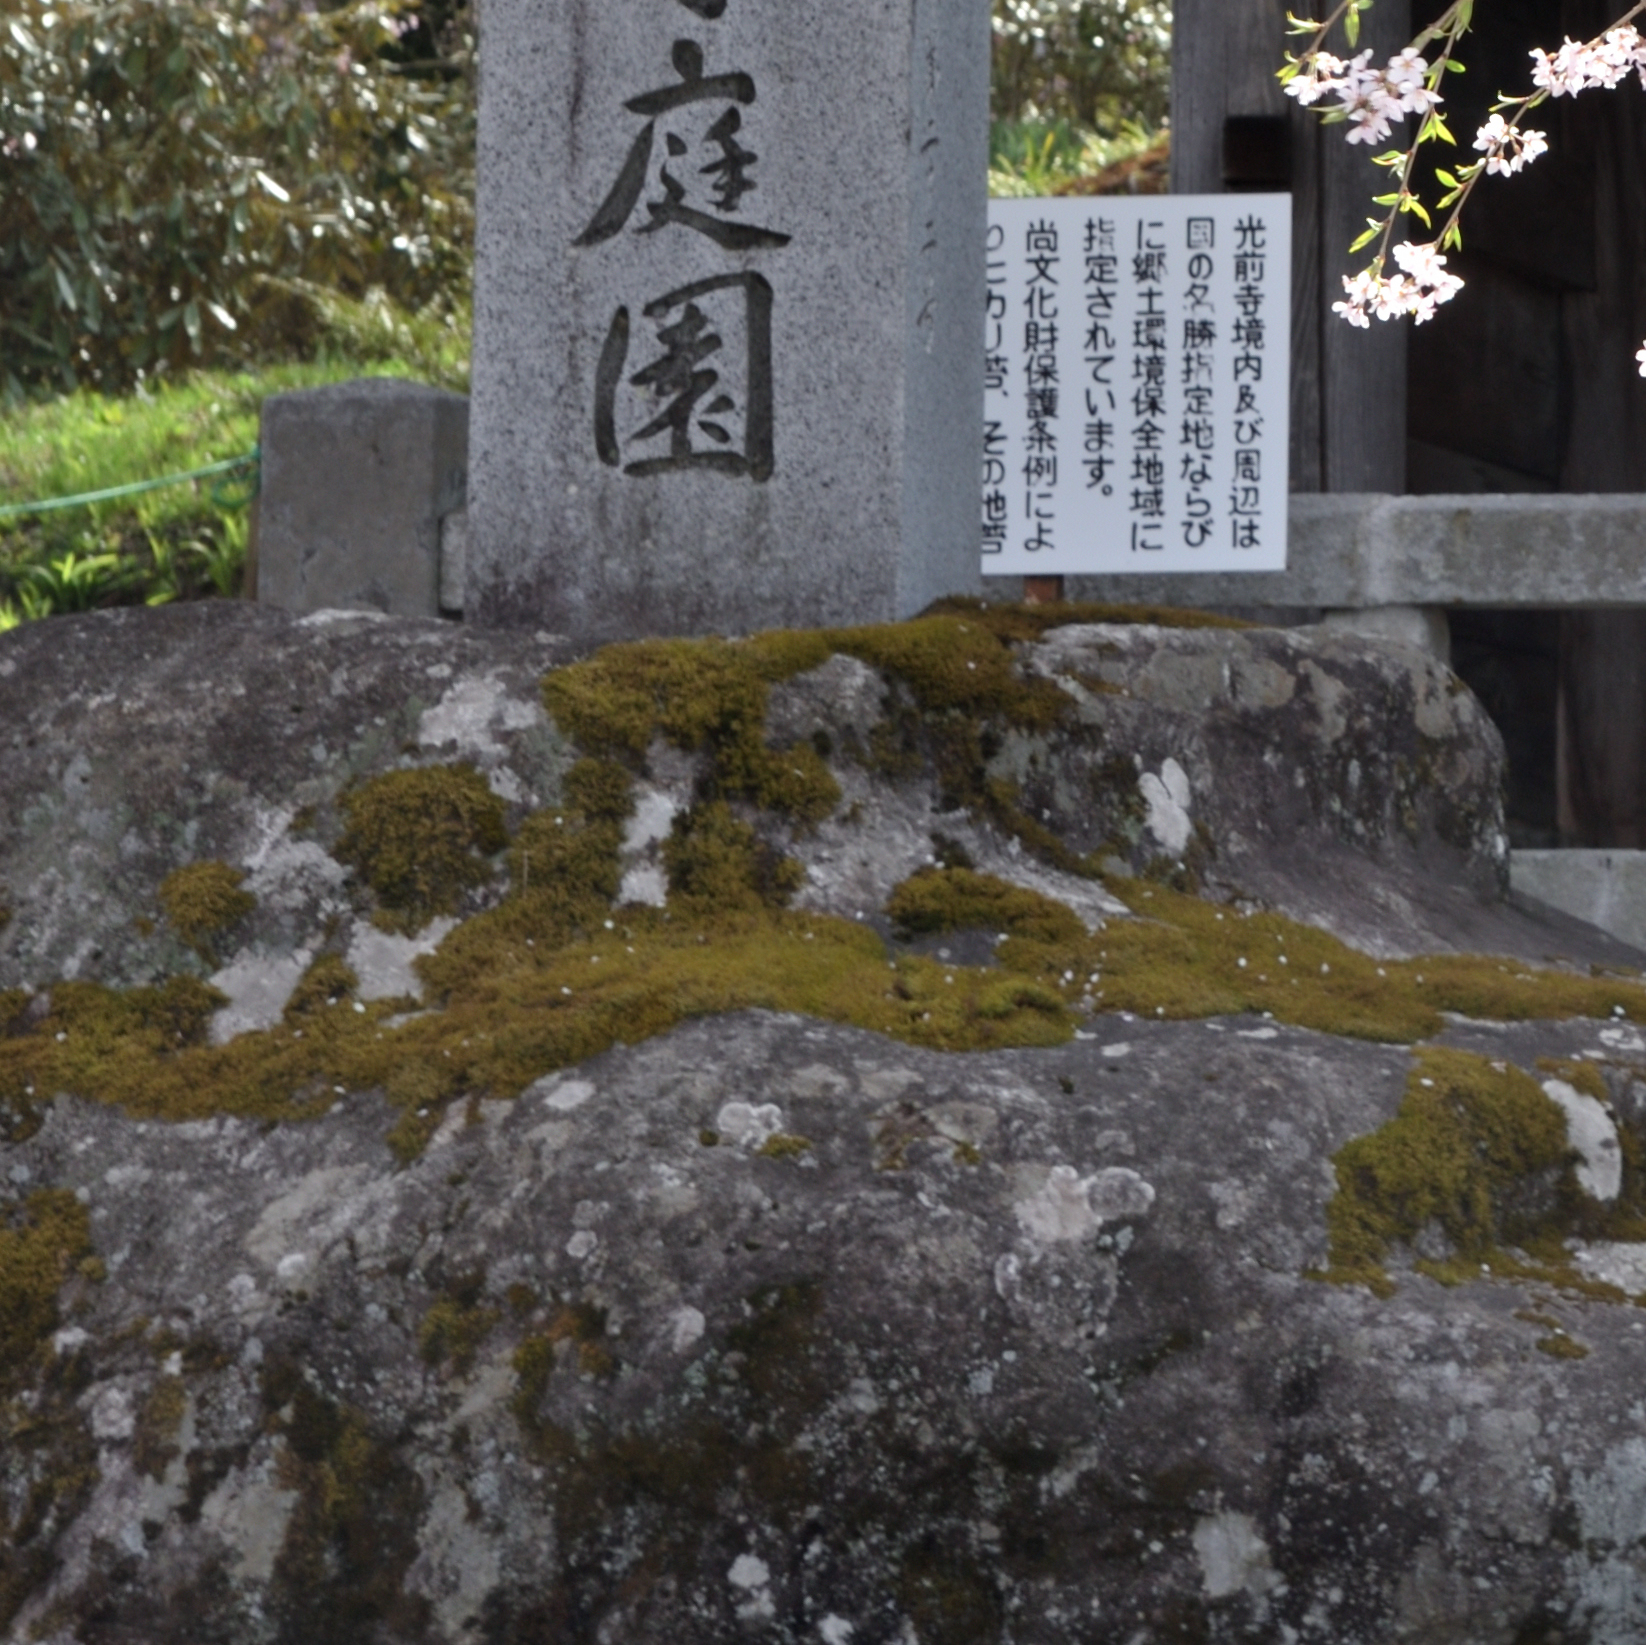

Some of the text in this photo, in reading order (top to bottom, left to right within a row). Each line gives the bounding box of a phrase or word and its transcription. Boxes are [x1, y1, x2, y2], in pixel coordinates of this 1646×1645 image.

[1022, 217, 1061, 553] 尚文化財保護条例によ
[1082, 217, 1117, 497] 指定されています。
[1130, 219, 1168, 552] に郷土環境保全地域に
[1180, 217, 1217, 548] 国の名勝指定地ならび
[1229, 214, 1267, 549] 光前寺境内及び周辺は
